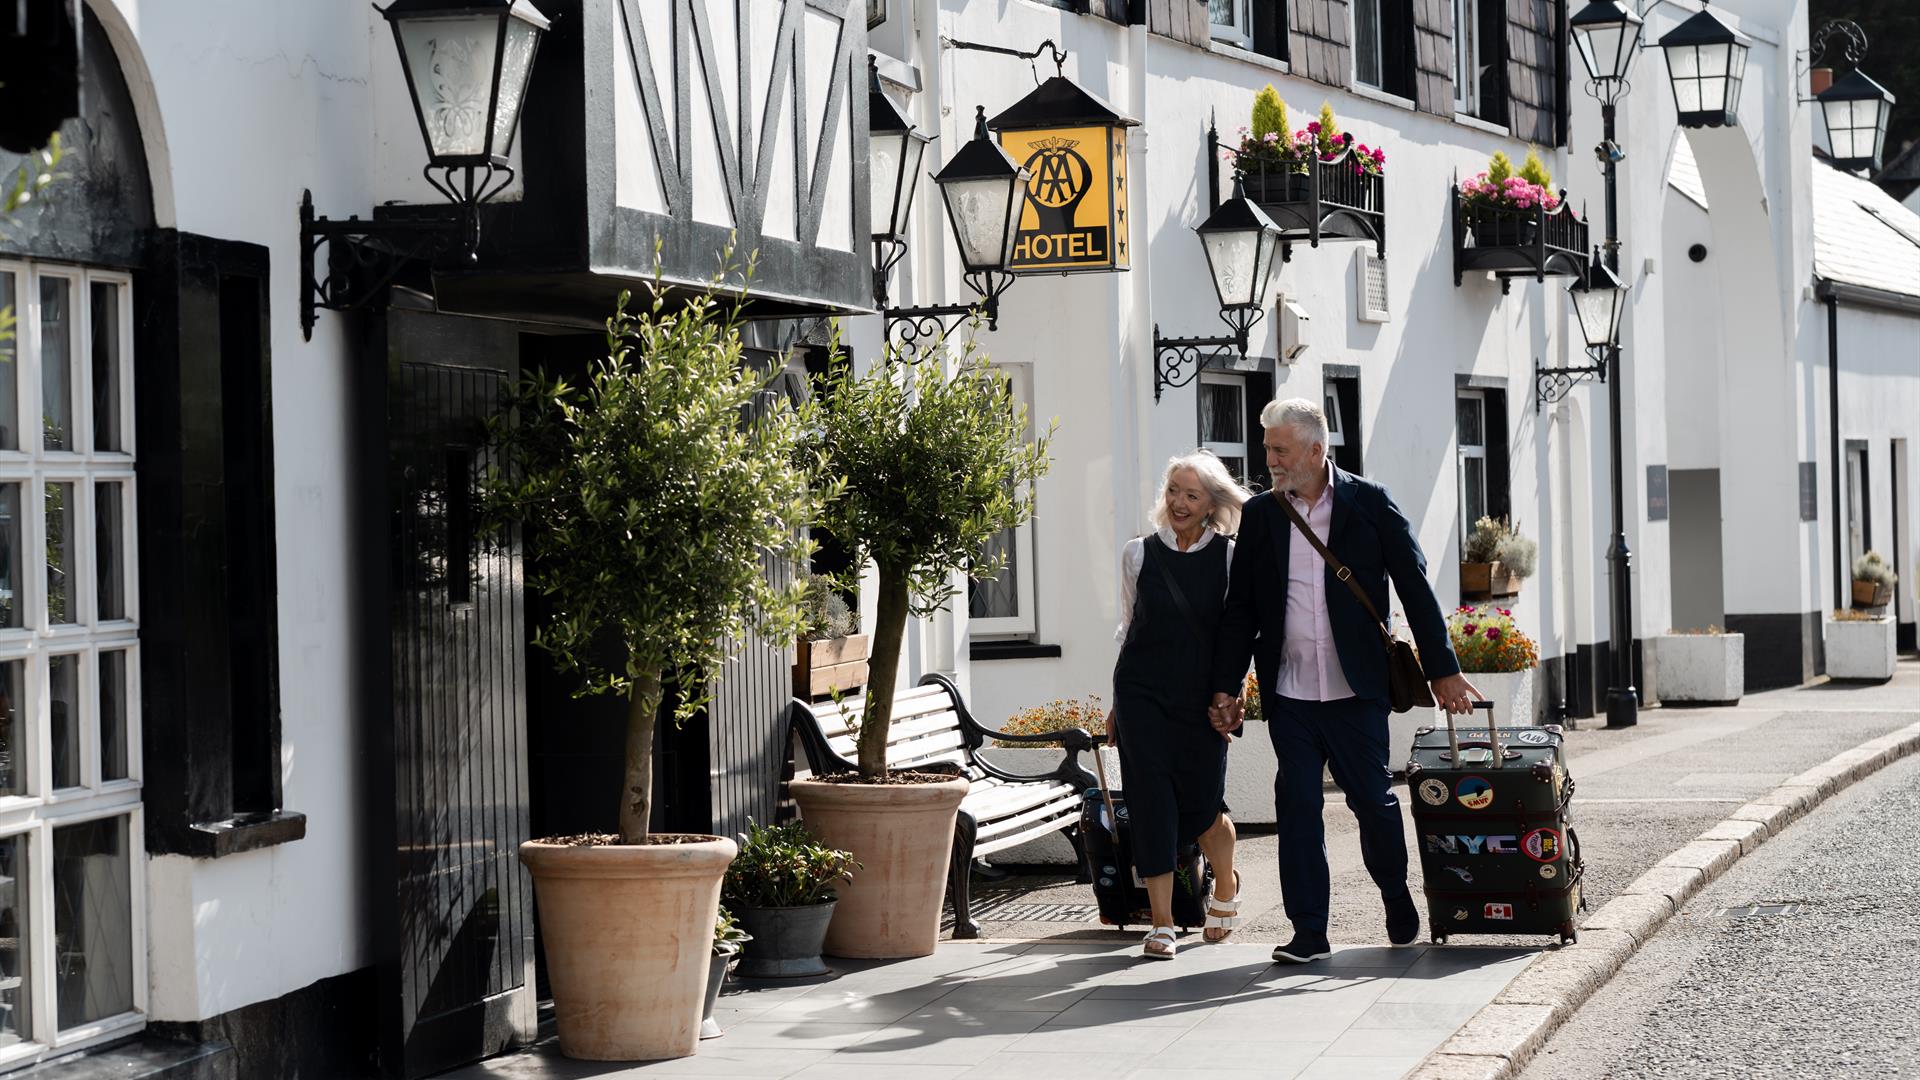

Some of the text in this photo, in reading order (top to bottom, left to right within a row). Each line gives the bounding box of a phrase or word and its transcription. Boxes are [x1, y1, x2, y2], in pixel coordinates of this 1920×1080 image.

[1013, 232, 1103, 260] HOTEL
[1467, 797, 1489, 808] JAWS
[1425, 835, 1518, 854] NYC
